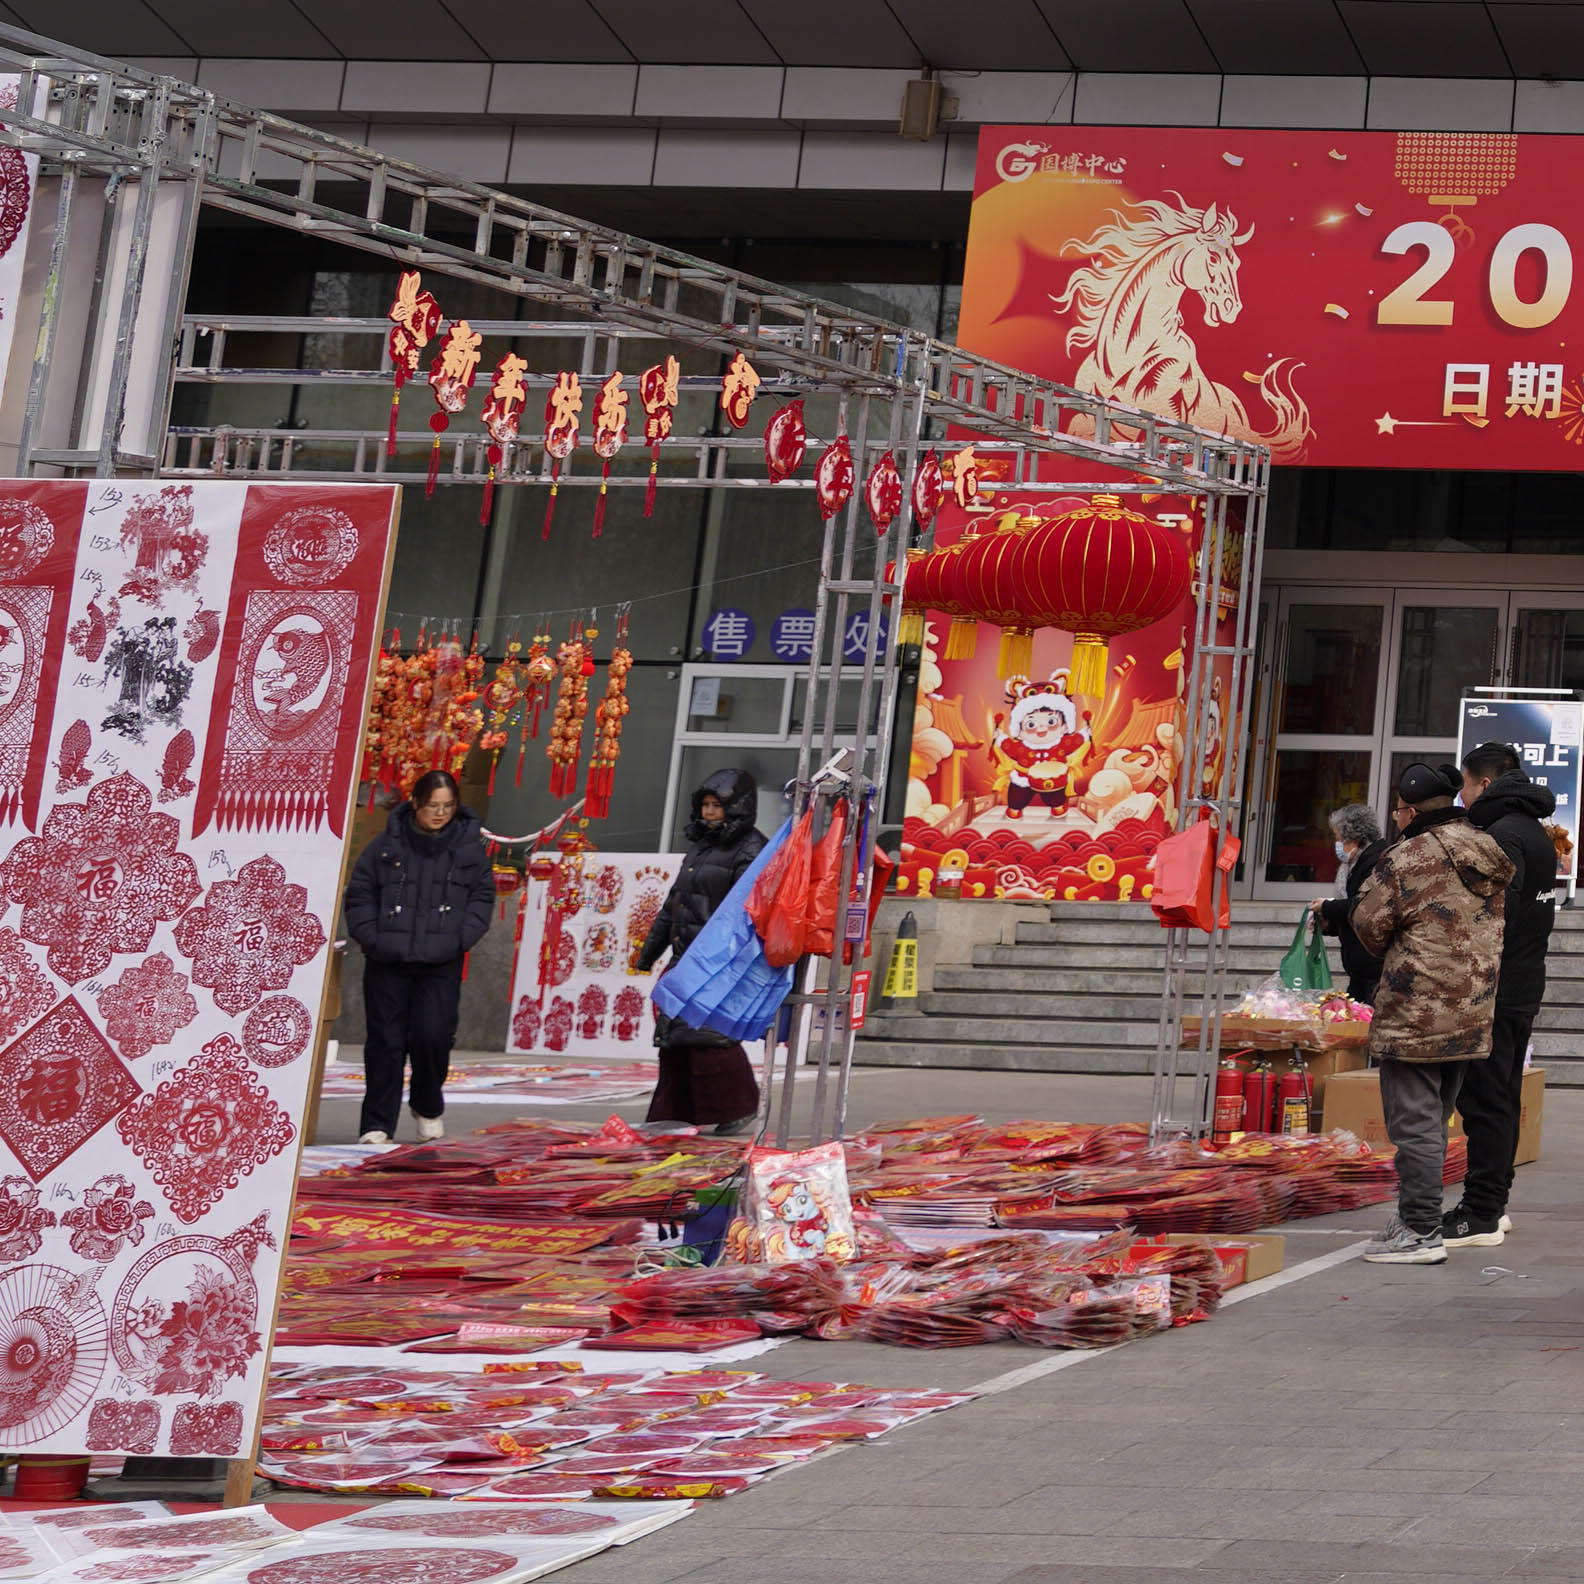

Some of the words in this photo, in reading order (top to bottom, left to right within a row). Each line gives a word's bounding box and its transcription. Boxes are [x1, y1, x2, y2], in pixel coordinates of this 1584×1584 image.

[1040, 152, 1127, 177] 国博中心
[100, 486, 122, 502] 152
[89, 535, 107, 550] 153
[707, 612, 887, 658] 售票处
[75, 857, 118, 900] 福
[233, 920, 265, 953] 福
[137, 995, 157, 1017] 福
